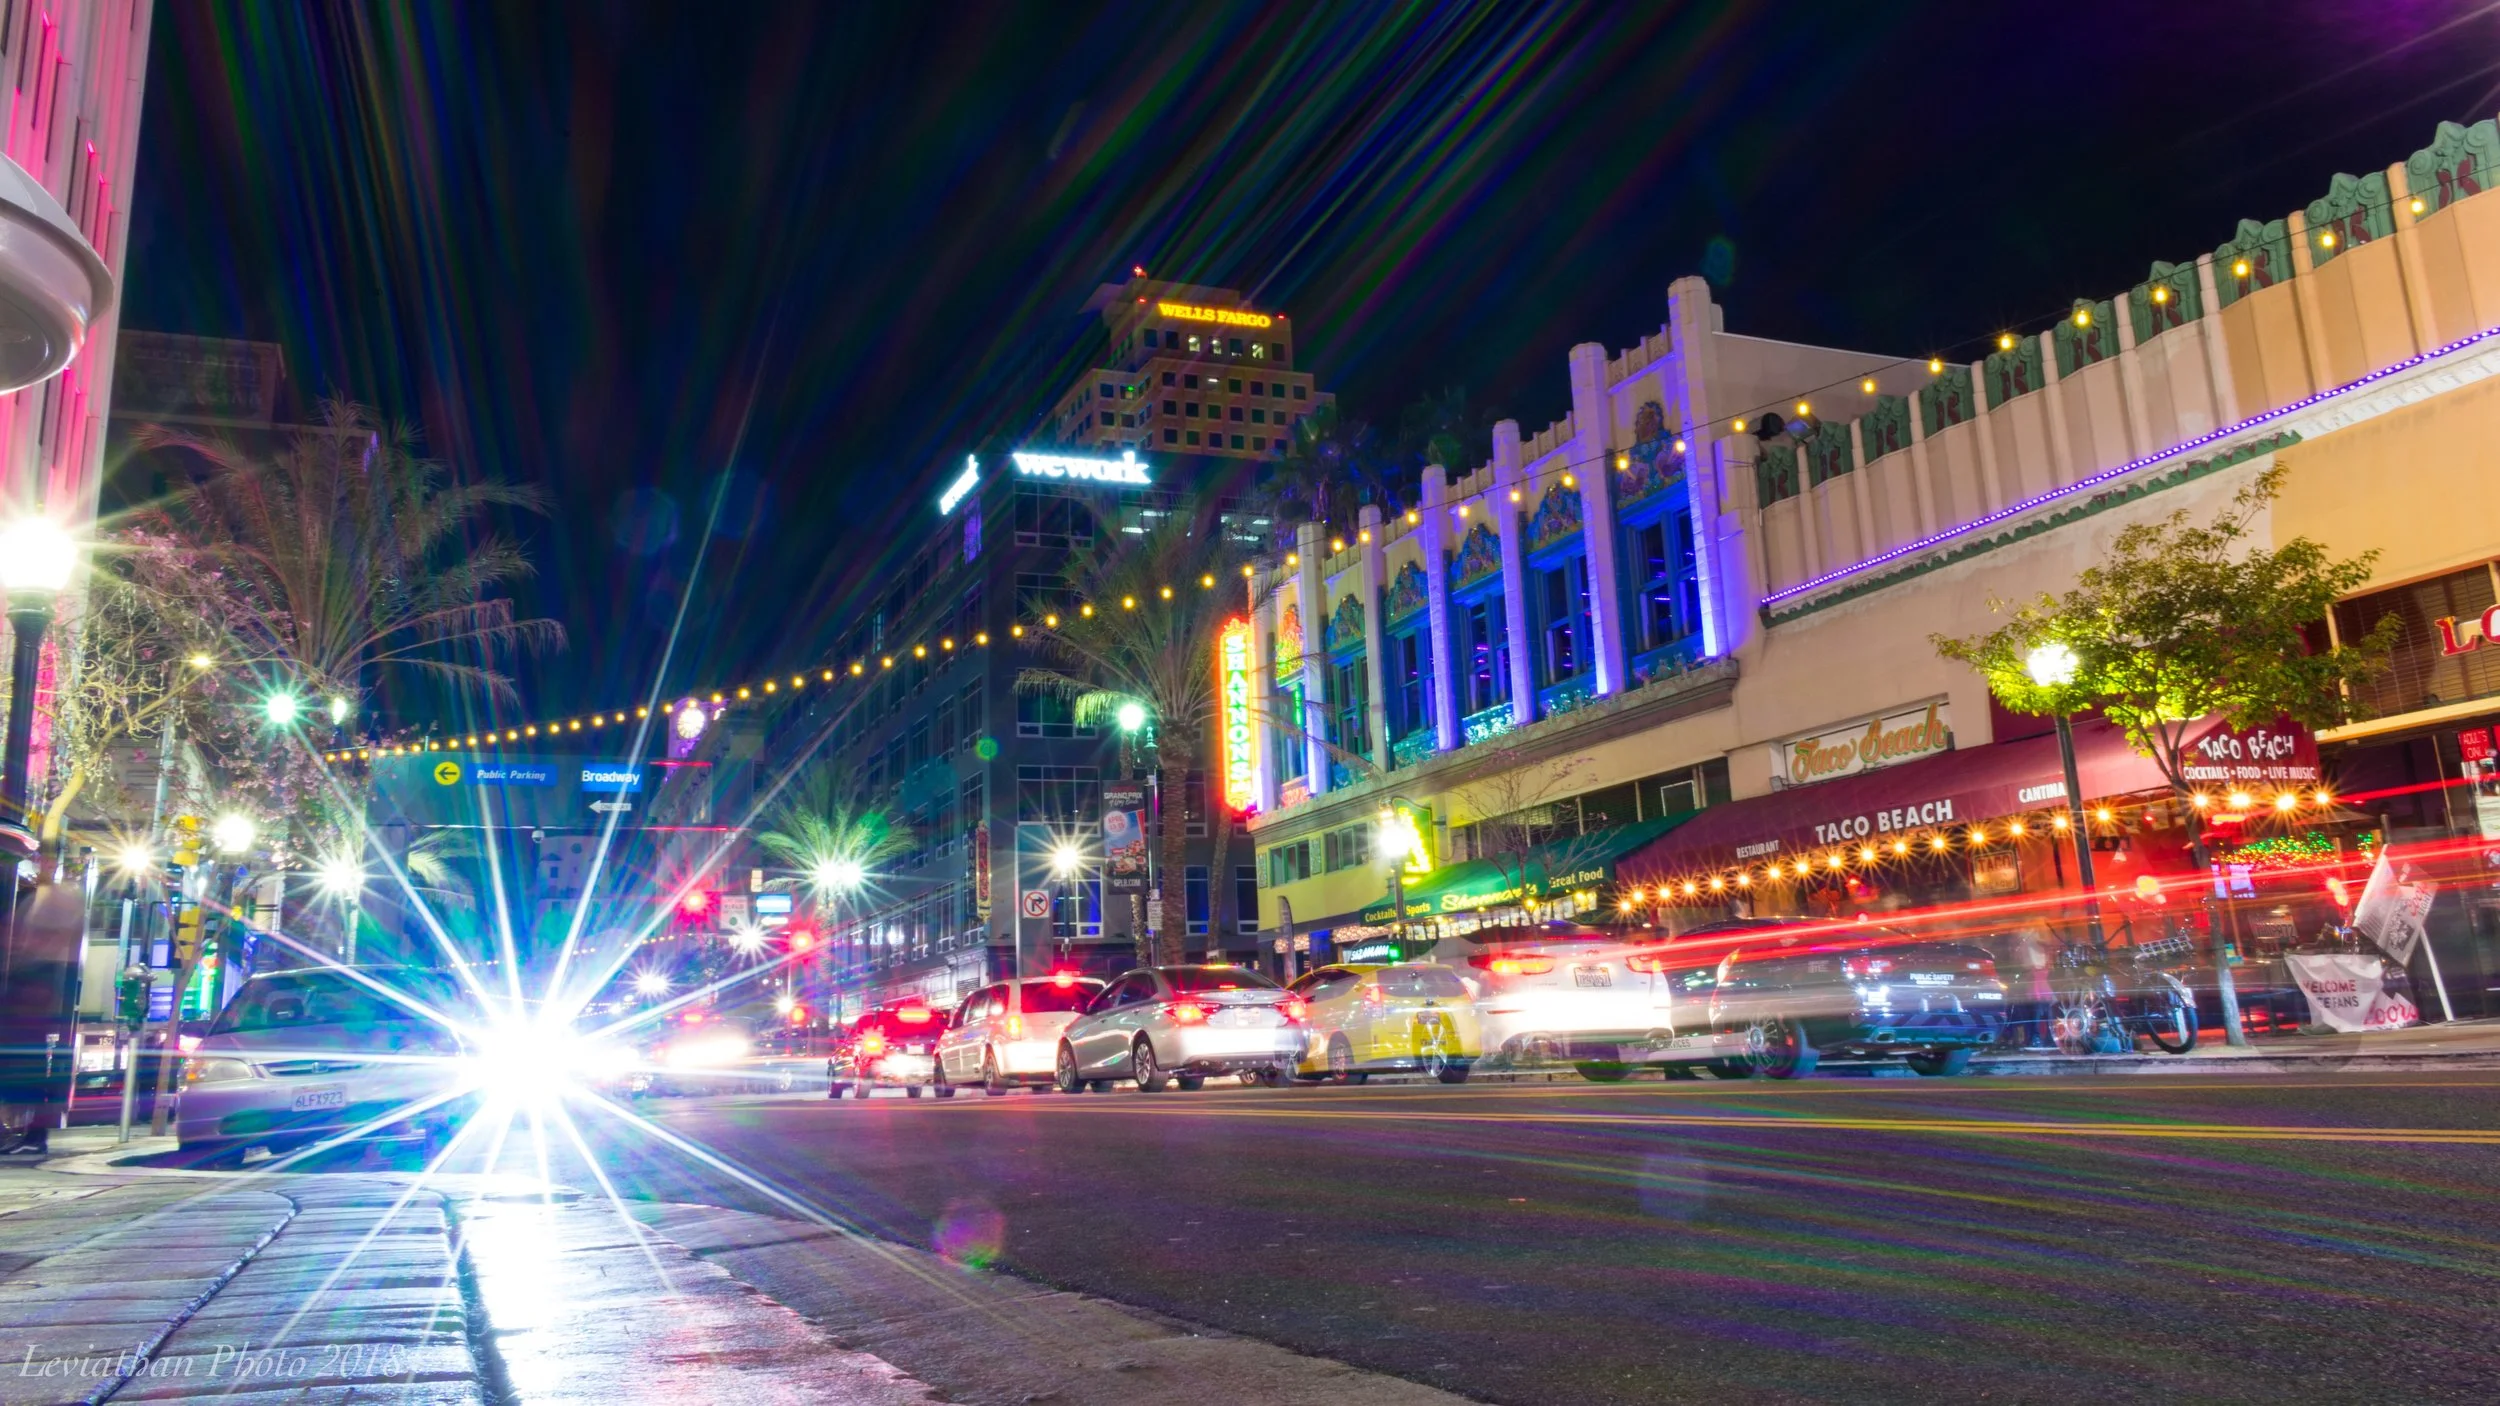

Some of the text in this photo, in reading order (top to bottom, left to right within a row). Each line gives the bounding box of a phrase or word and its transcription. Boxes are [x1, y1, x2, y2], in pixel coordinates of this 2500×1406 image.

[1158, 303, 1271, 328] WELLS FARGO
[1014, 450, 1151, 484] wework
[1792, 702, 1949, 783] Taco Beach
[2198, 730, 2294, 760] TACO BEACH
[477, 769, 546, 782] Public Parking
[582, 770, 640, 786] Broadway
[2184, 766, 2316, 780] COCKTAILS FOOD LIVE MUSIC
[2018, 781, 2067, 803] CANTINA
[1816, 799, 1954, 845] TACO BEACH
[1736, 839, 1779, 859] RESTAURANT
[1549, 866, 1604, 888] Great Food
[1440, 883, 1538, 911] Shannon's
[1364, 901, 1430, 923] Cocktails Sports
